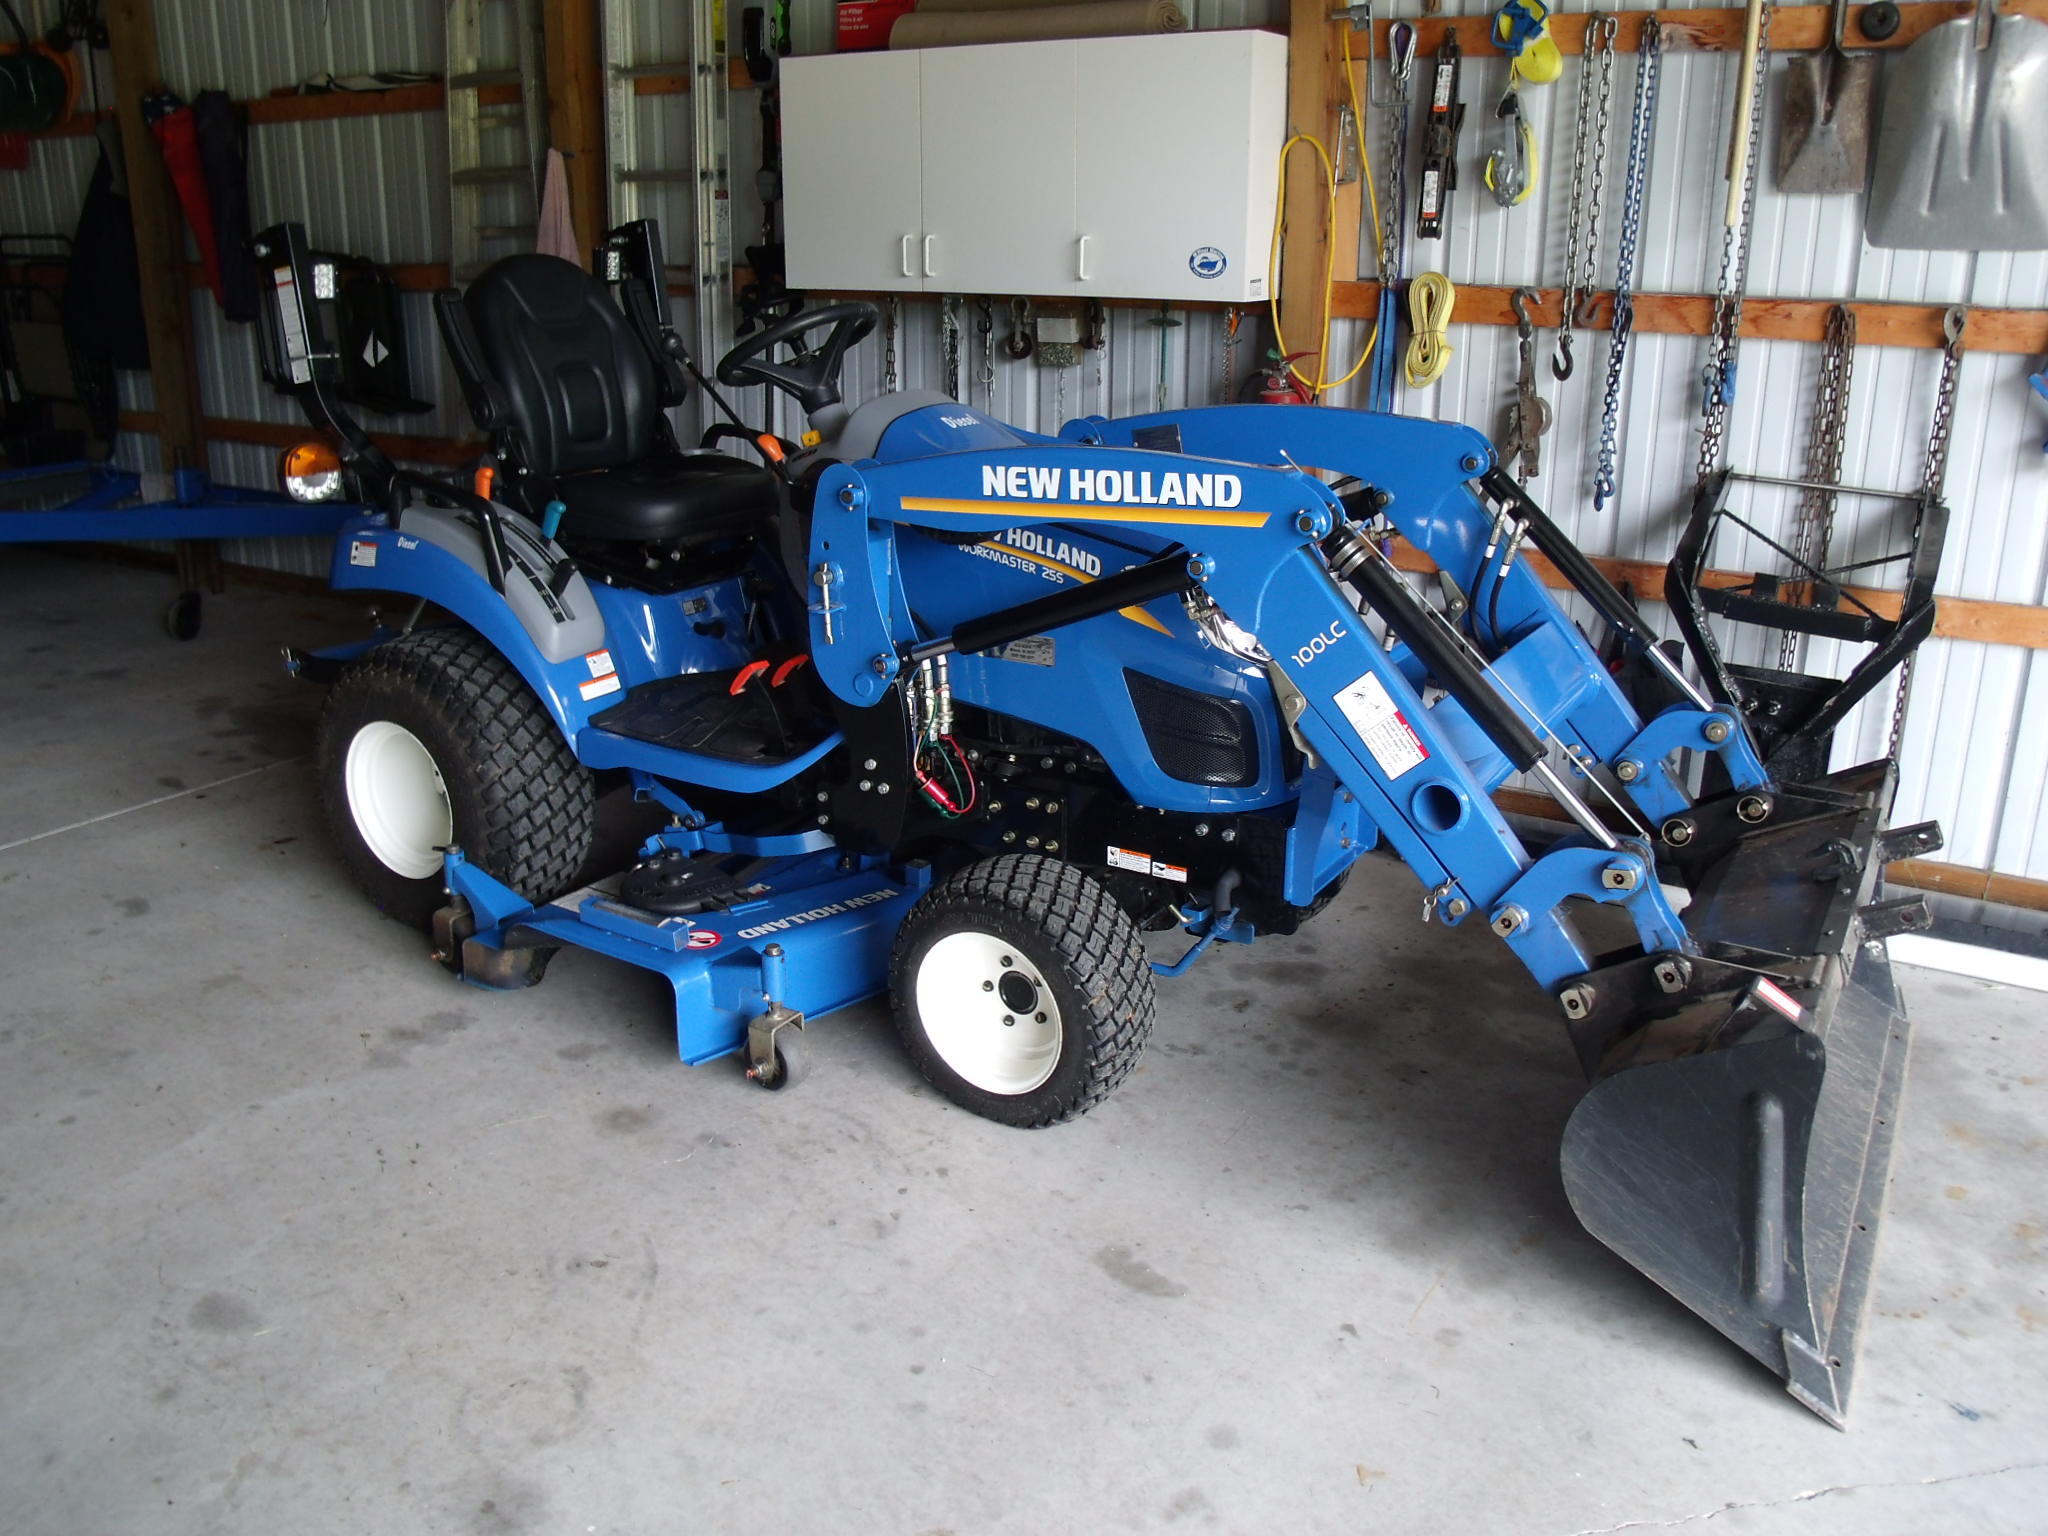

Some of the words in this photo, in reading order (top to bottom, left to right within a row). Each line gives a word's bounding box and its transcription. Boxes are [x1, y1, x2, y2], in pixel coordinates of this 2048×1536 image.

[940, 413, 980, 428] Diesel
[982, 465, 1062, 500] NEW
[1069, 468, 1243, 508] HOLLAND
[397, 536, 420, 551] Diesel
[1006, 527, 1102, 578] HOLLAND
[1291, 619, 1348, 668] 100LC
[843, 888, 899, 912] NEW
[736, 903, 848, 940] HOLLAND
